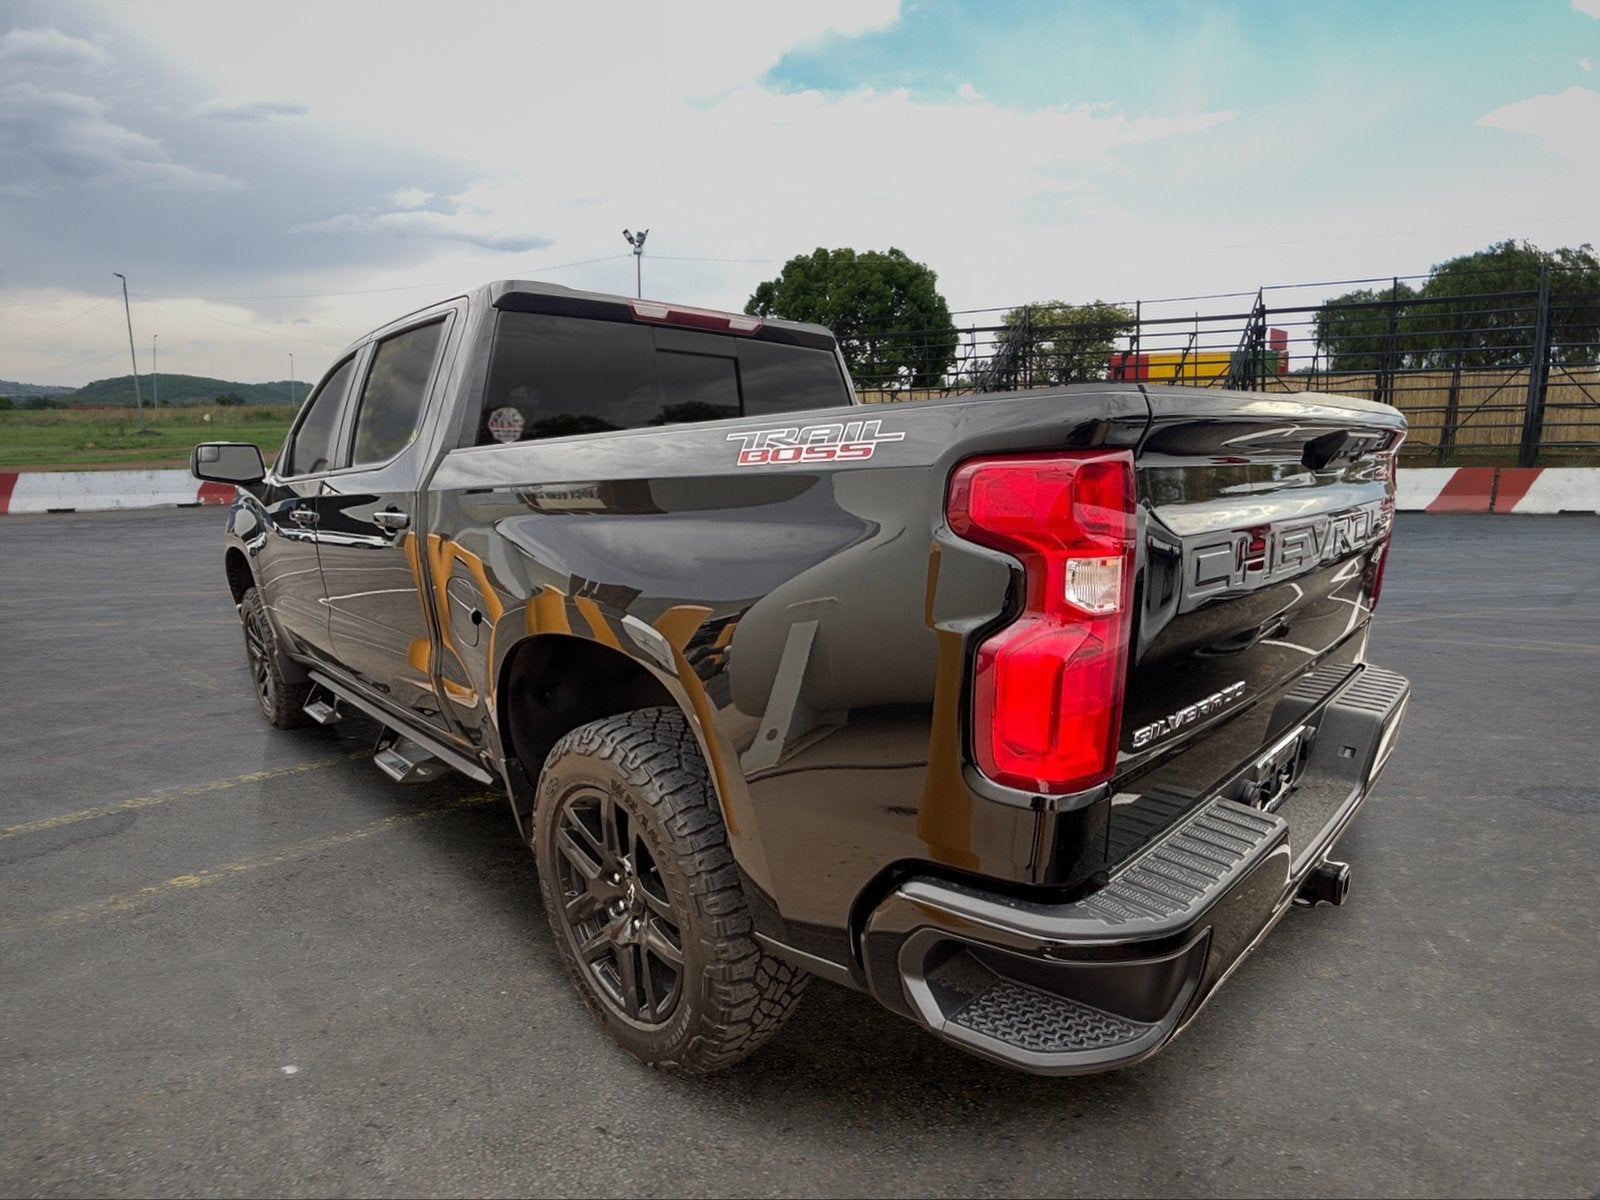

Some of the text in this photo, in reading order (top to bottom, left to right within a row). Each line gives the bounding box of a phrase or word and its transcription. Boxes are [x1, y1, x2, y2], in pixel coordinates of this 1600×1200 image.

[726, 419, 906, 449] TRAIL
[737, 441, 877, 467] BOSS
[1187, 507, 1393, 599] CHEVROL
[1132, 680, 1246, 748] SILVERADO
